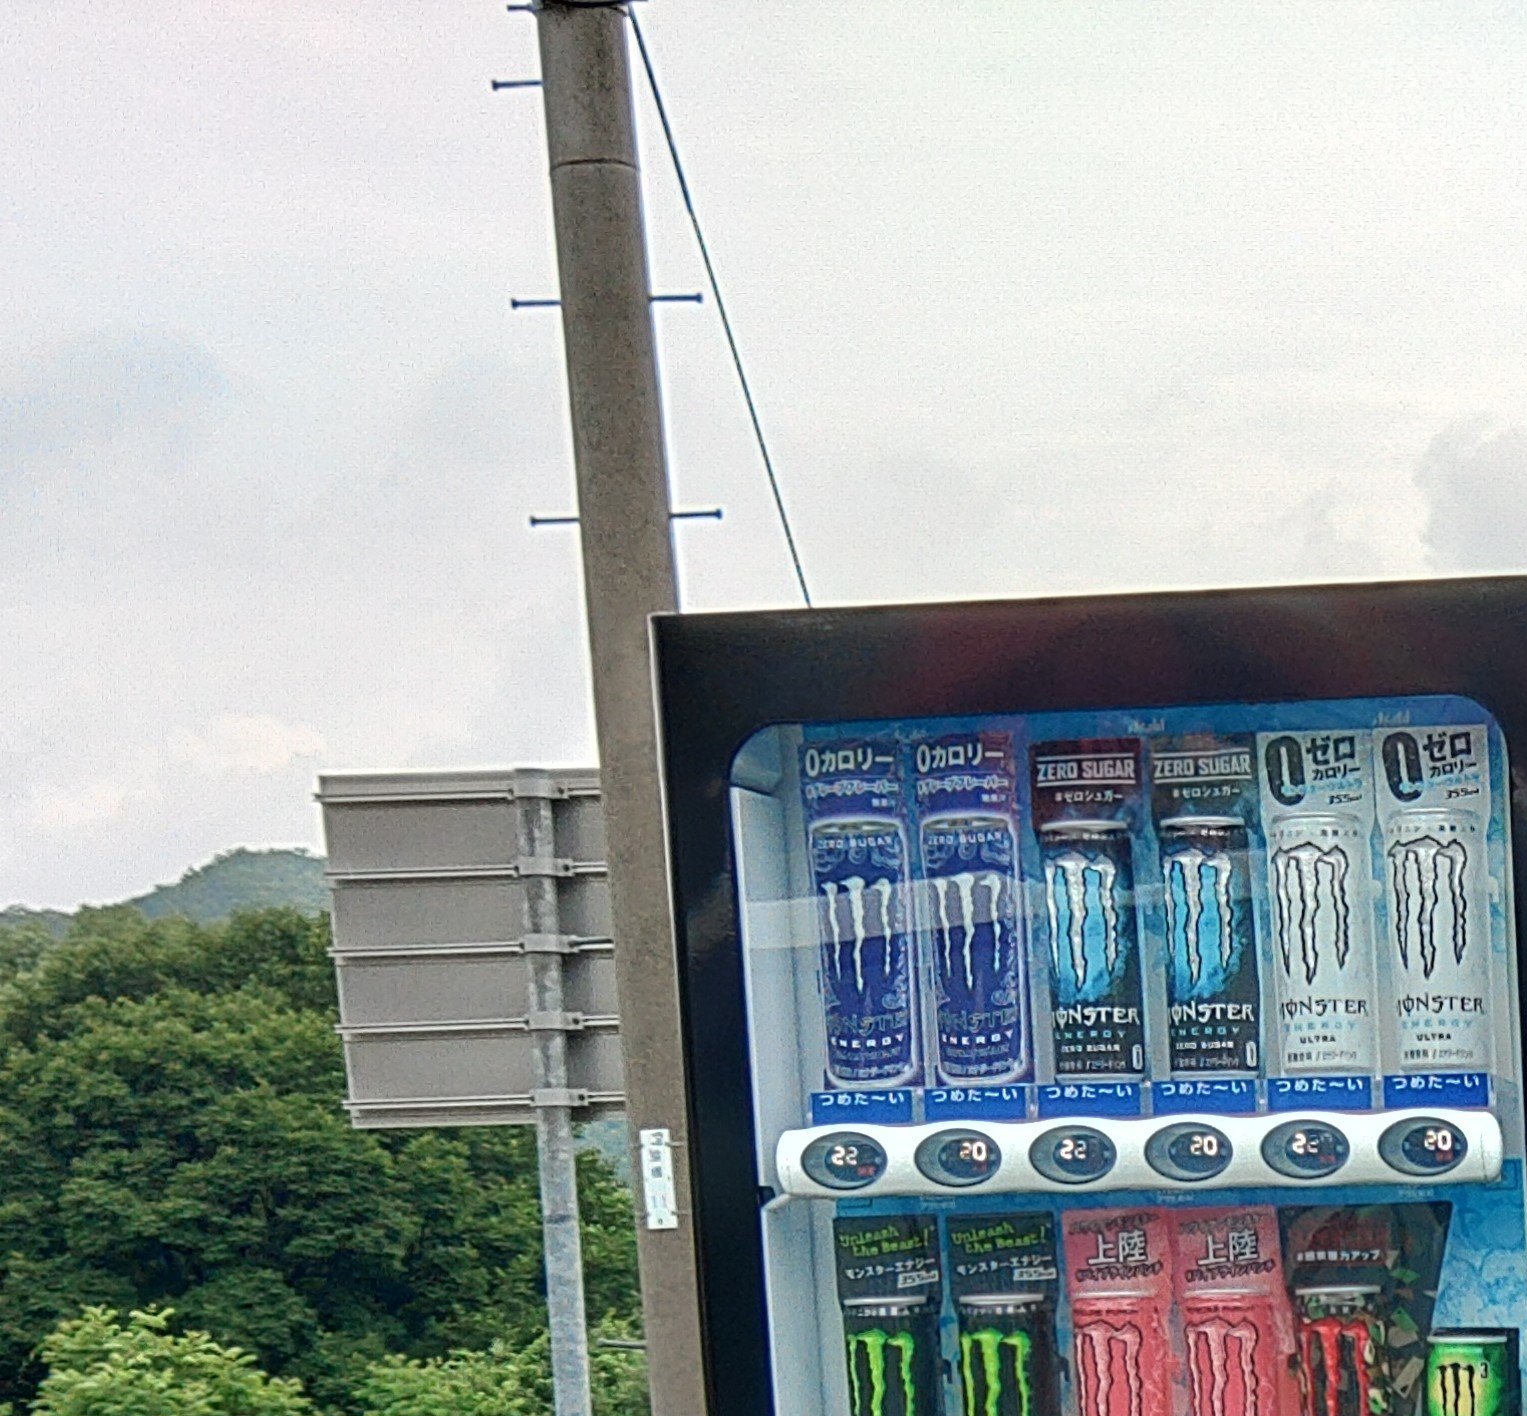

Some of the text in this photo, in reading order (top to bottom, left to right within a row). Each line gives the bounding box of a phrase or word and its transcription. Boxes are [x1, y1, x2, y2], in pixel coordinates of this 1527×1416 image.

[1036, 756, 1135, 781] ZERO SUGAR
[1154, 756, 1195, 777] ZERO
